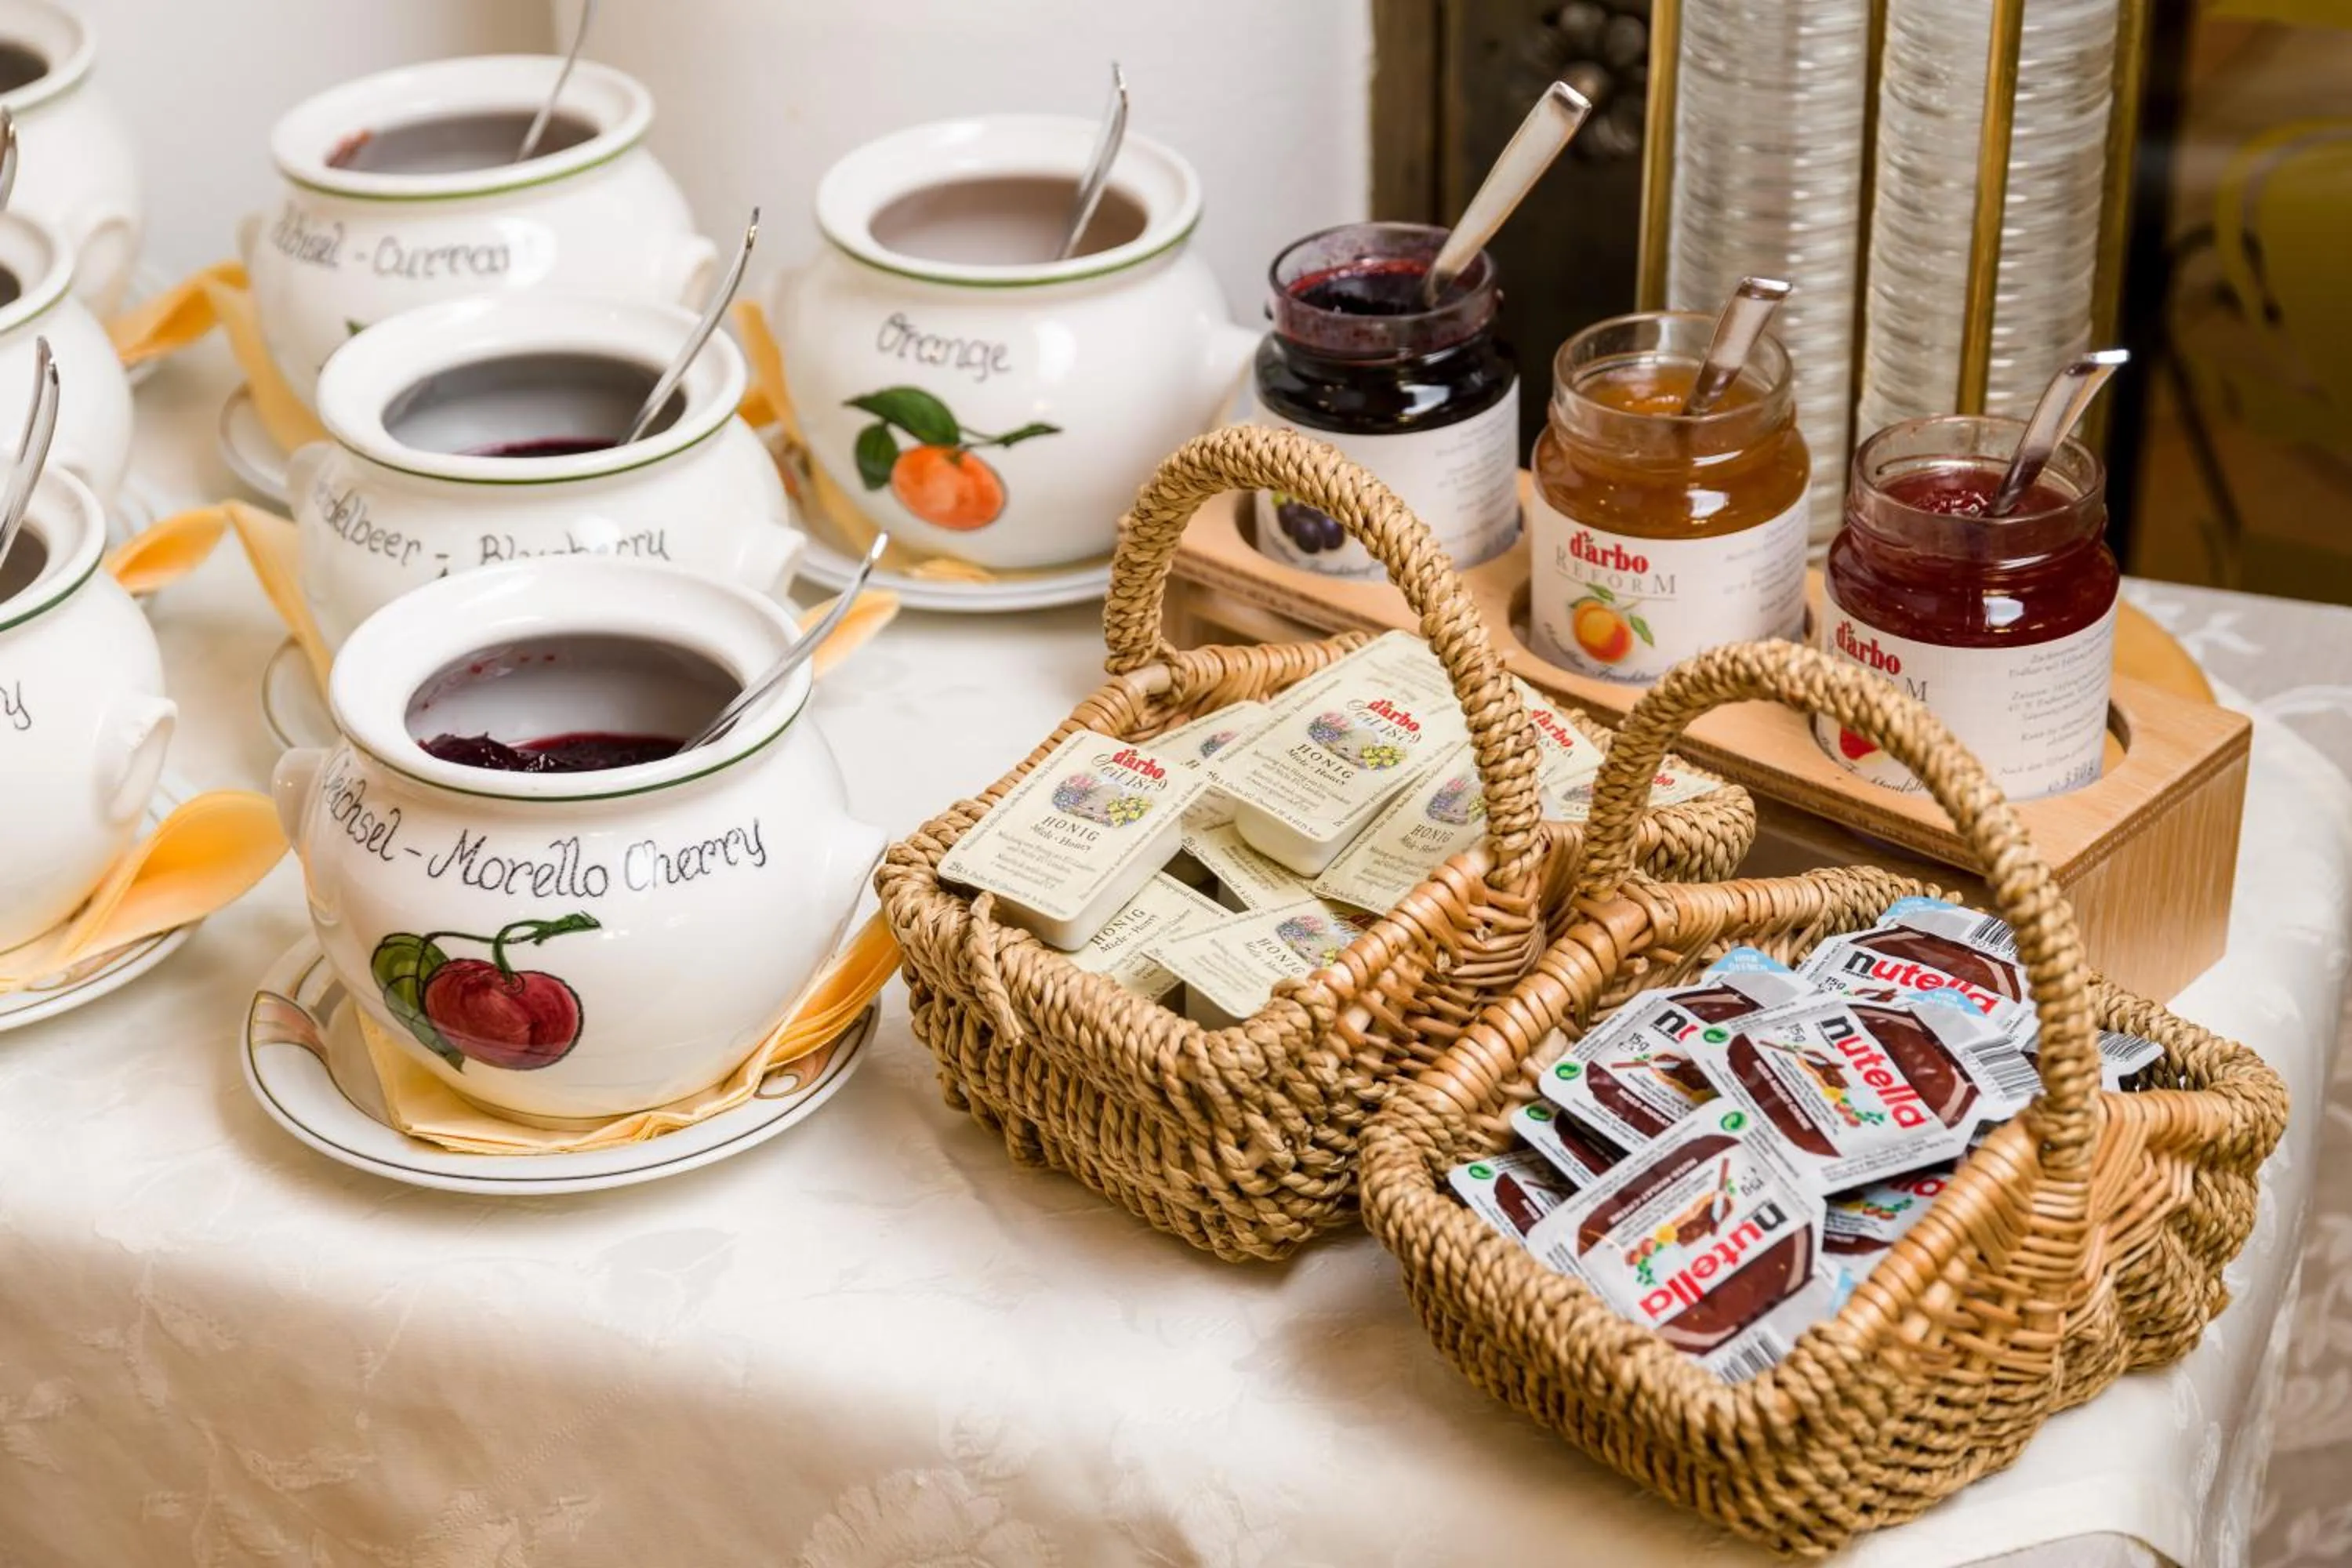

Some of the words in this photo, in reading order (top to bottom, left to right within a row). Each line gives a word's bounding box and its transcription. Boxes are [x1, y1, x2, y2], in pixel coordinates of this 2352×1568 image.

[373, 235, 530, 280] Curran
[876, 312, 1012, 383] Orange
[479, 529, 671, 566] Blbrry
[1555, 544, 1677, 595] REFORM
[1296, 744, 1356, 780] HONIG
[1040, 815, 1102, 843] HONIG
[1410, 823, 1456, 844] HONIG
[427, 829, 610, 898] Morello
[626, 818, 767, 891] Cherry
[1820, 1015, 1927, 1129] nutella
[1639, 1202, 1788, 1320] nutella
